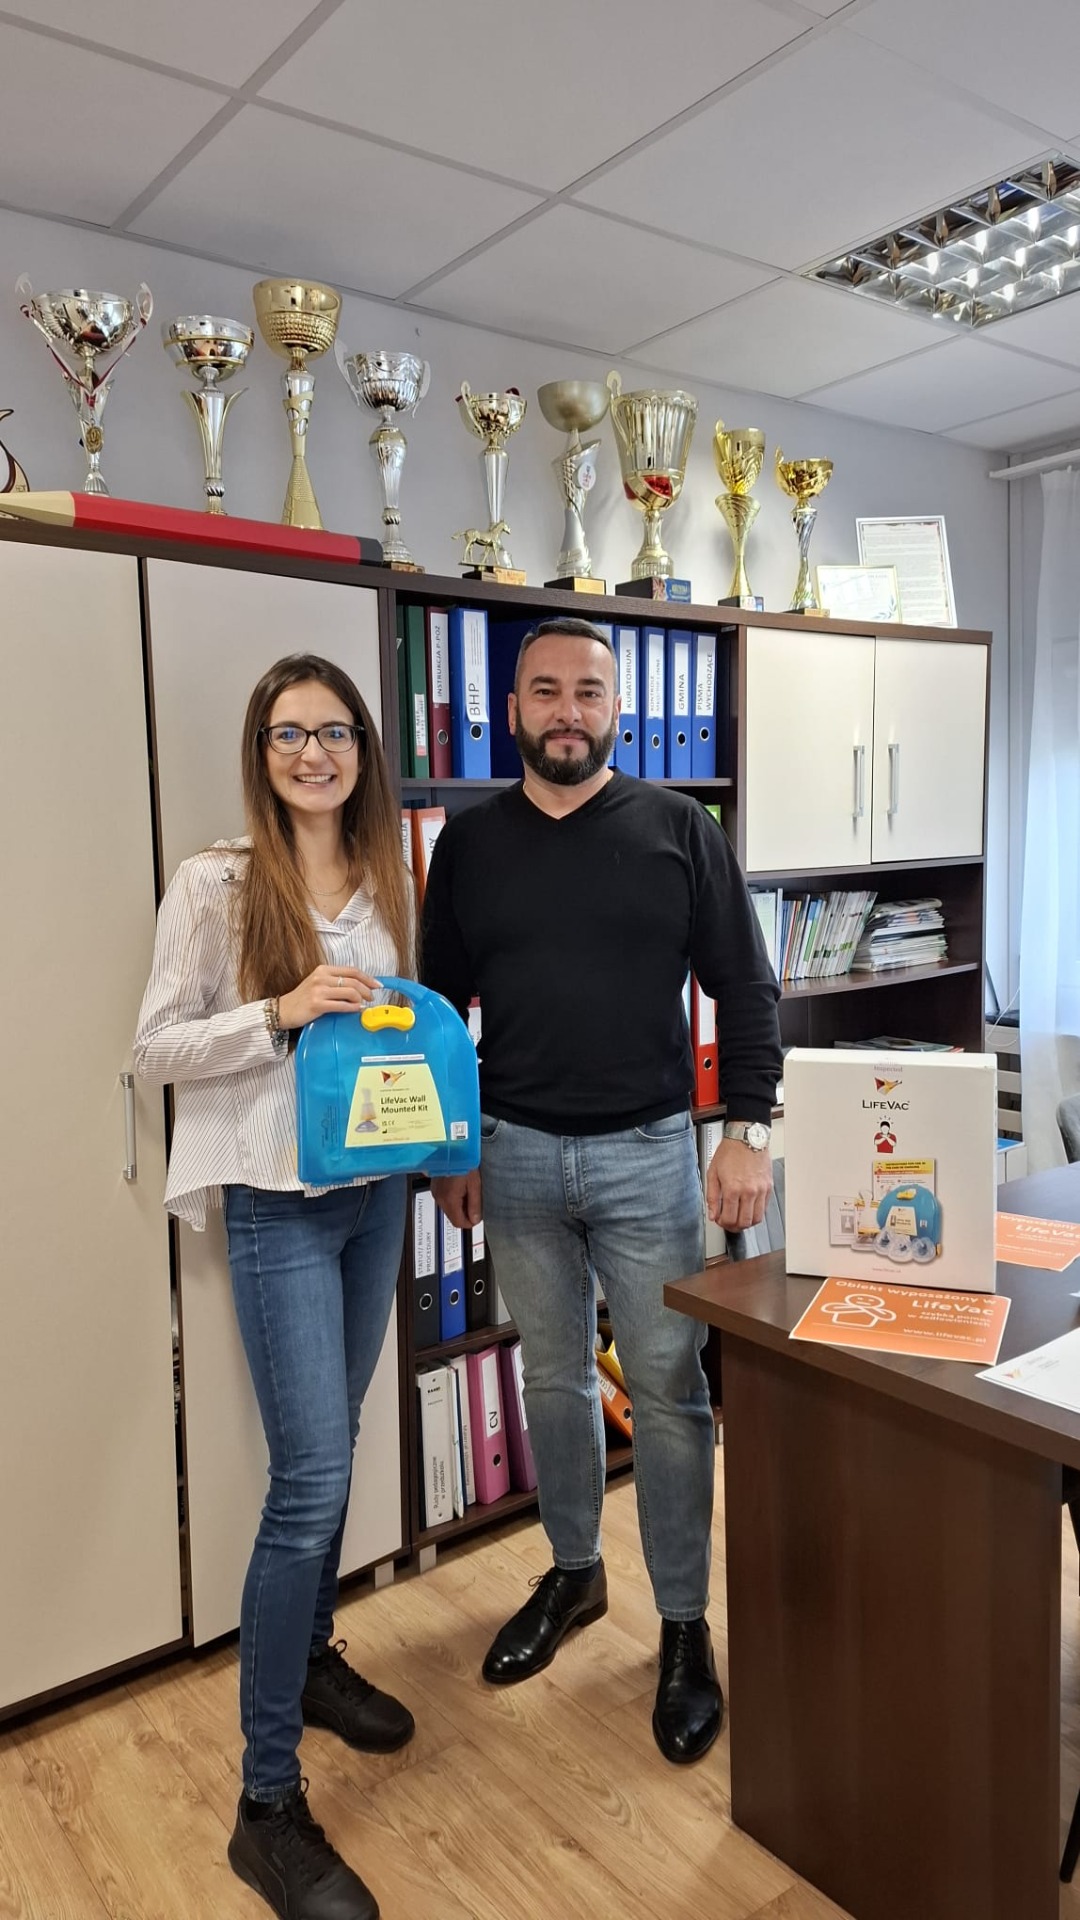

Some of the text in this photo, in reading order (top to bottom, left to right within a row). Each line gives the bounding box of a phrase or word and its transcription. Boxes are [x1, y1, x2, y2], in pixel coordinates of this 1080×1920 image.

[435, 650, 443, 697] INSTRUKCJA
[706, 653, 714, 711] WYCHODZĄCE
[468, 682, 481, 717] BHP
[380, 1094, 426, 1105] LifeVac Wall
[381, 1104, 428, 1114] Mounted Kit
[835, 1280, 997, 1305] Obiekt wyposażony w
[911, 1299, 994, 1316] LifeVac
[903, 1328, 987, 1344] www.lifevac.pl
[489, 1411, 498, 1429] CV
